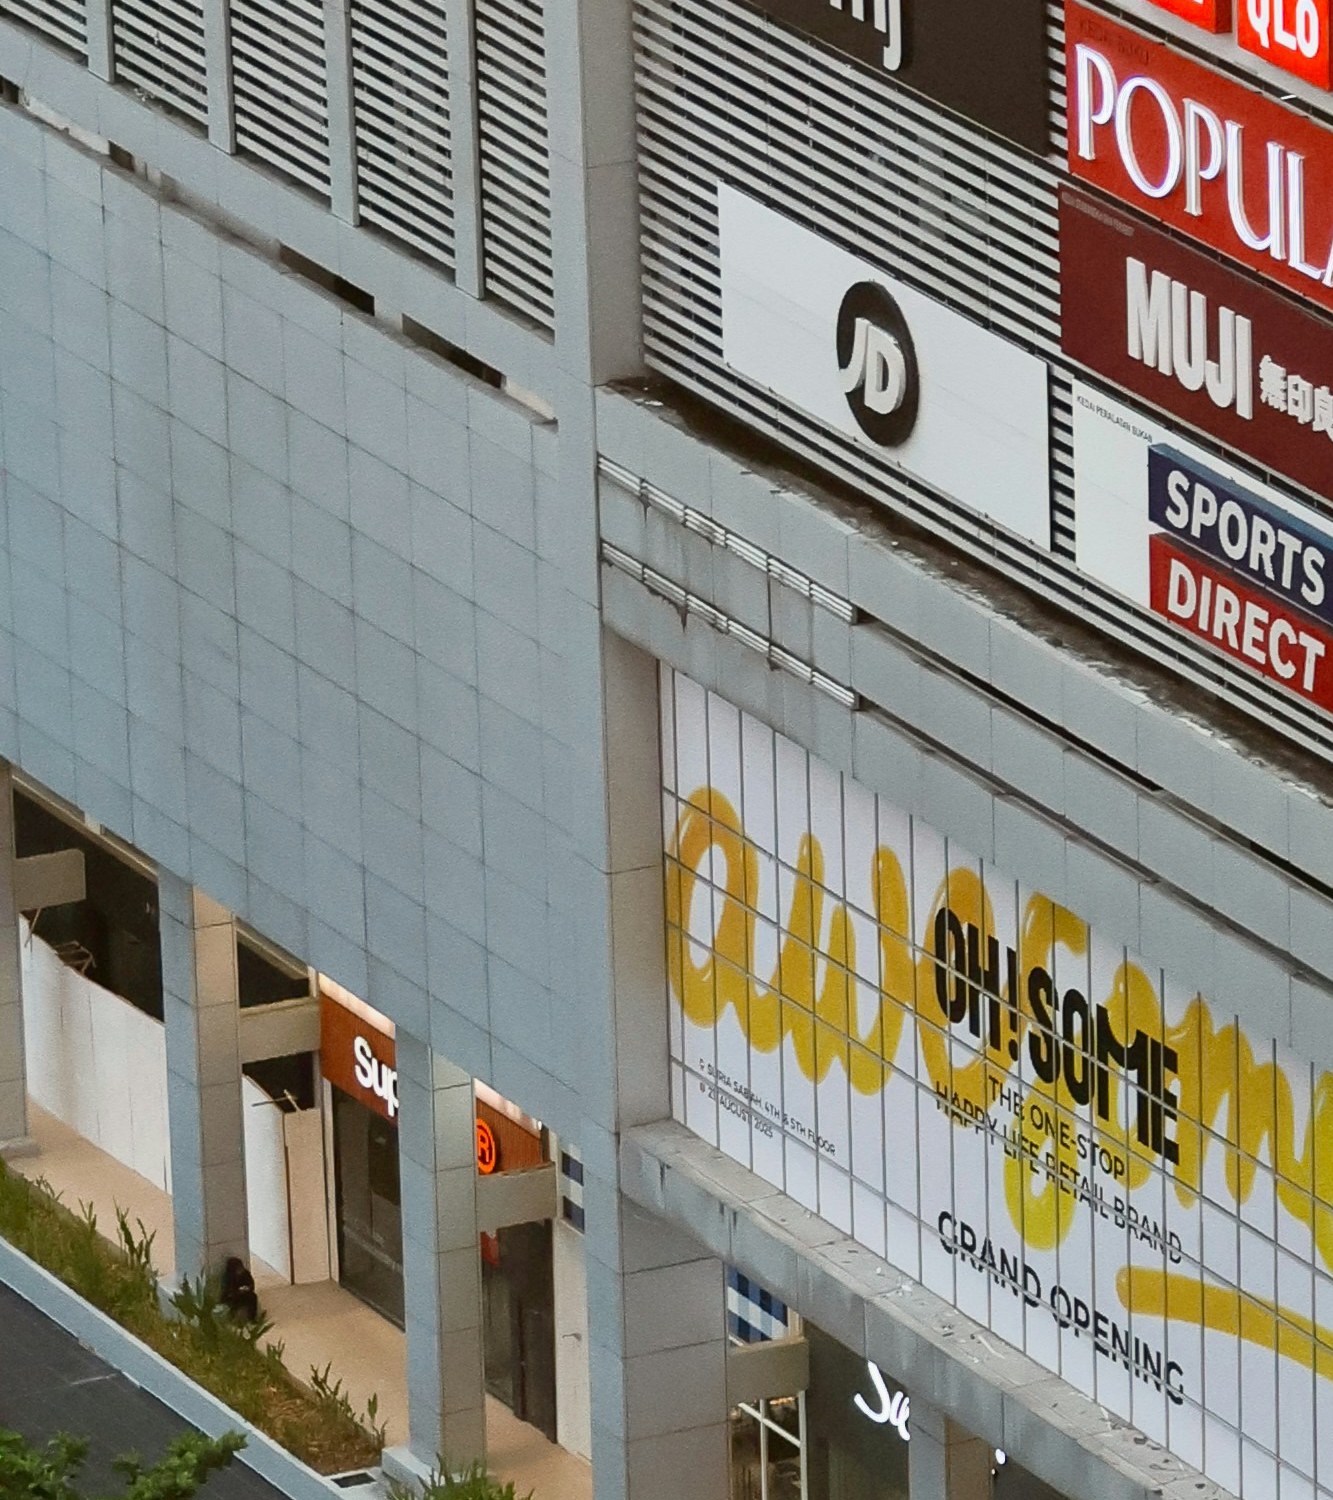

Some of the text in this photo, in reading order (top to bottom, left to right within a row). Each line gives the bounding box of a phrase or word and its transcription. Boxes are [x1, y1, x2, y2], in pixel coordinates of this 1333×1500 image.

[837, 317, 907, 415] JD
[1126, 256, 1253, 421] MUJI
[1165, 469, 1326, 607] SPORTS
[1167, 557, 1326, 693] DIRECT
[936, 1080, 1183, 1265] HAPPY LIFE RETAIL BRAND
[988, 1074, 1125, 1181] THE ONE-STOP
[938, 1210, 1184, 1406] GRAND OPENING
